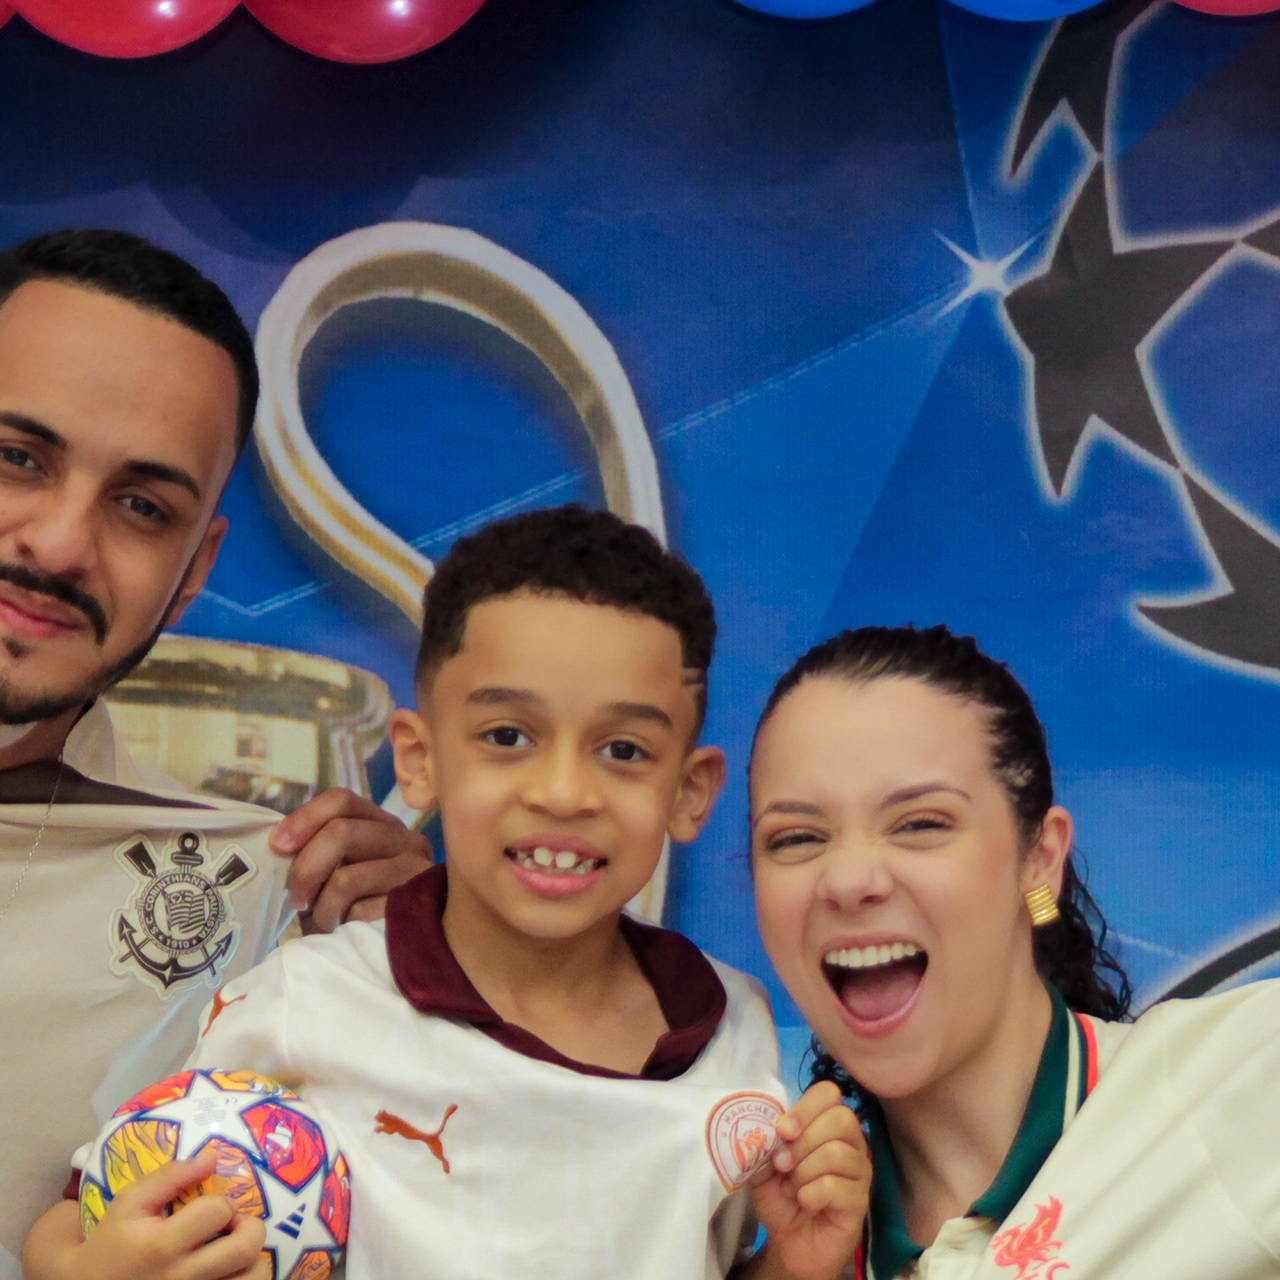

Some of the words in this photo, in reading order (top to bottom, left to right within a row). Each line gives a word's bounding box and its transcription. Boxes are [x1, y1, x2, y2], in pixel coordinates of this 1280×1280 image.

[145, 873, 207, 912] CORINTHIANS
[198, 889, 220, 940] PAULISTA
[166, 938, 190, 949] 1910
